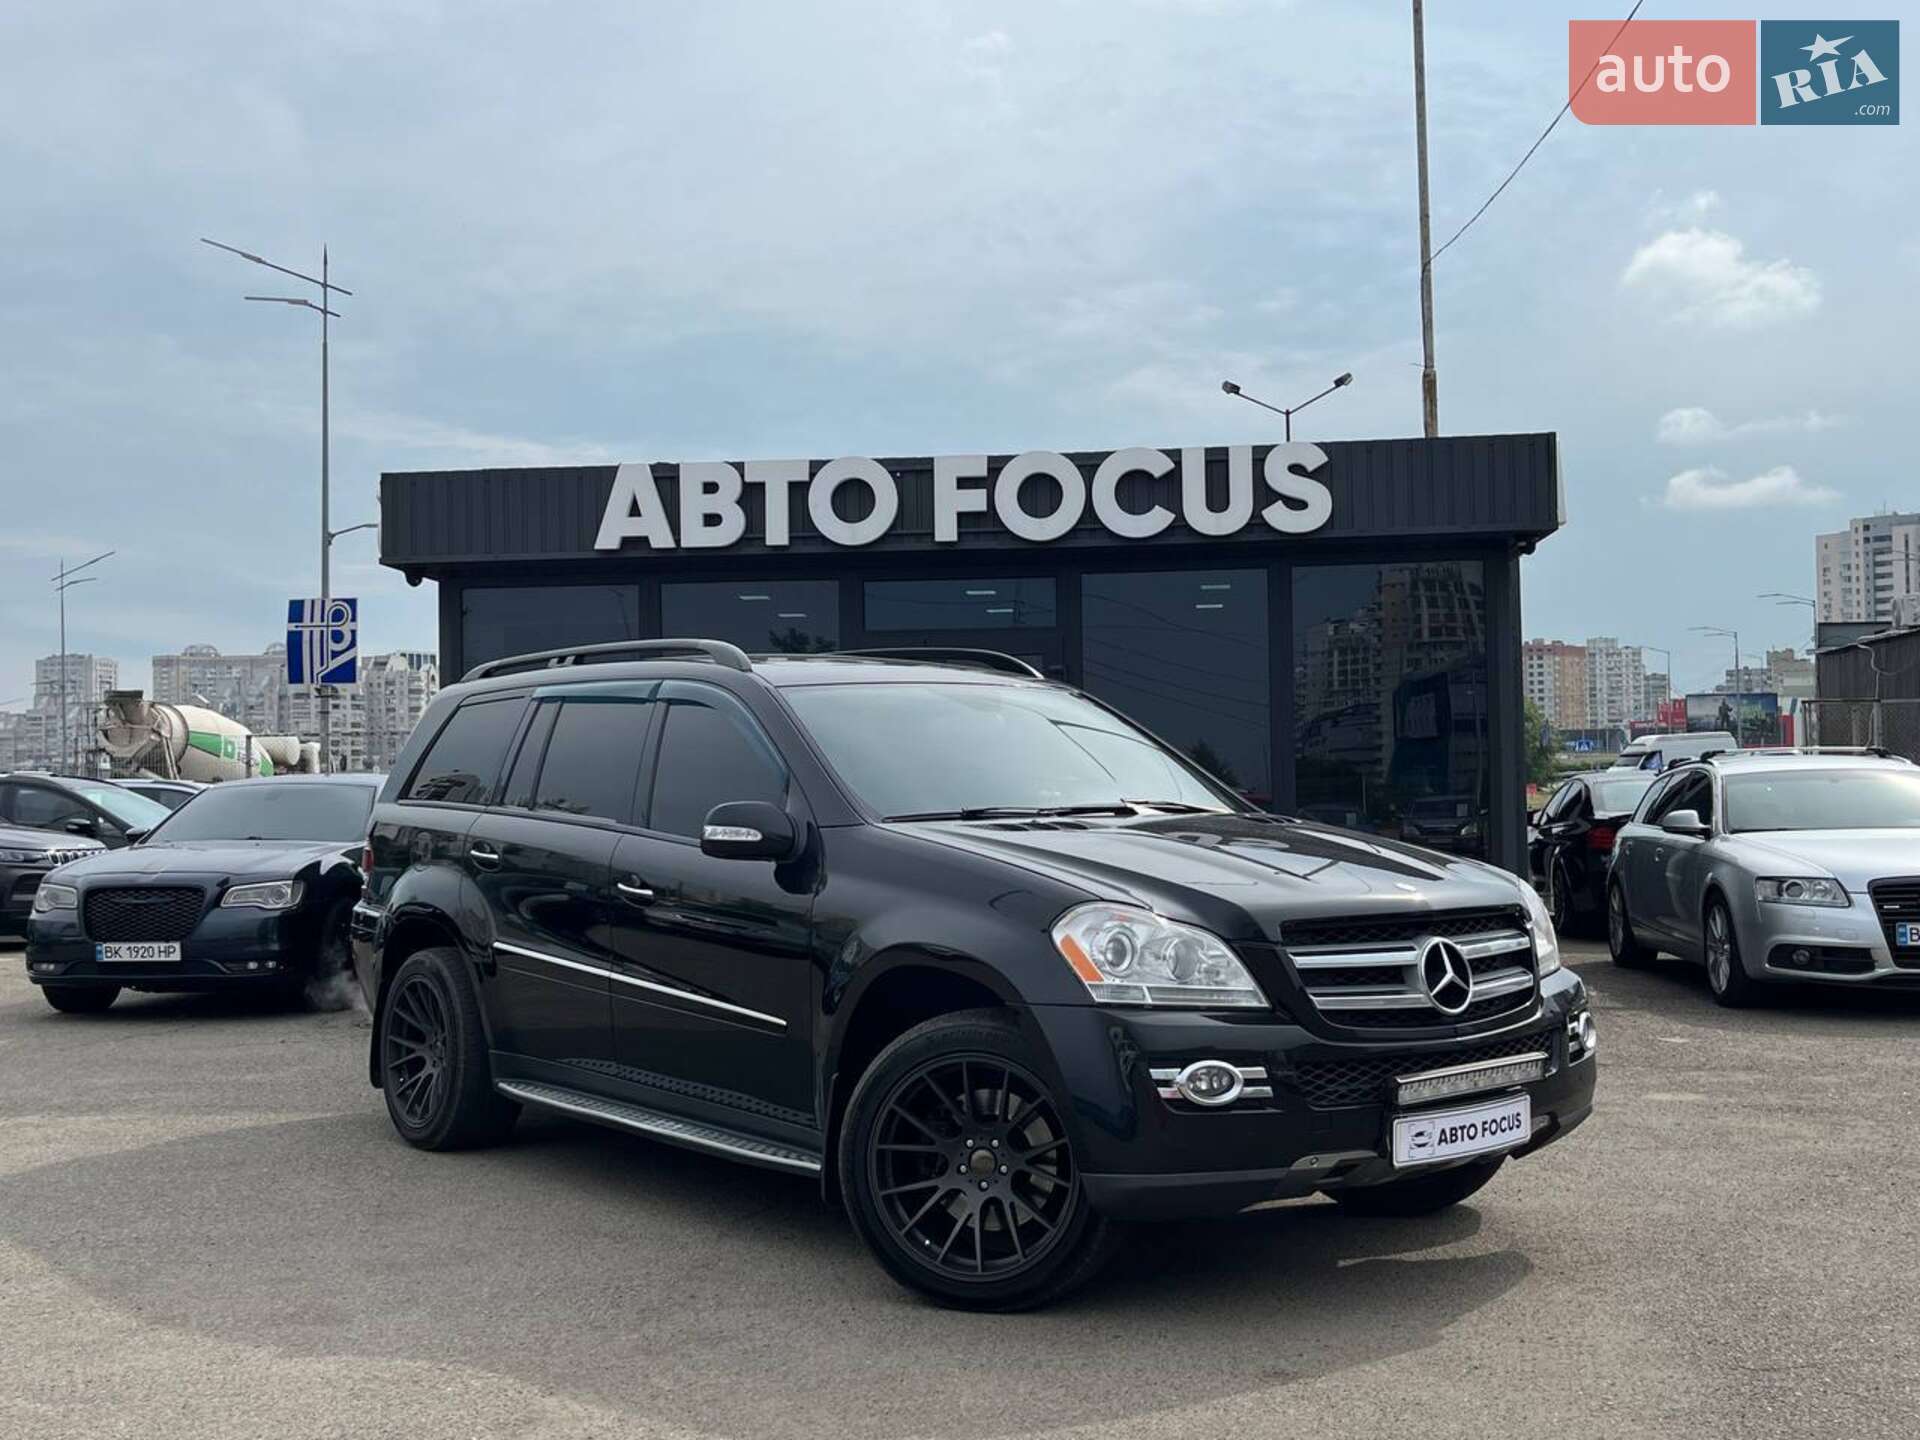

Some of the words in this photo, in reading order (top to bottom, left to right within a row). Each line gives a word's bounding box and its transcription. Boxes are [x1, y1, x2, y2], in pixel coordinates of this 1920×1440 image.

[593, 455, 900, 551] АВТО
[933, 442, 1334, 543] FOCUS
[105, 946, 122, 959] BK
[127, 946, 155, 959] 1920
[158, 945, 176, 958] HP
[1437, 1122, 1479, 1147] АВТО
[1481, 1112, 1522, 1138] FOCUS
